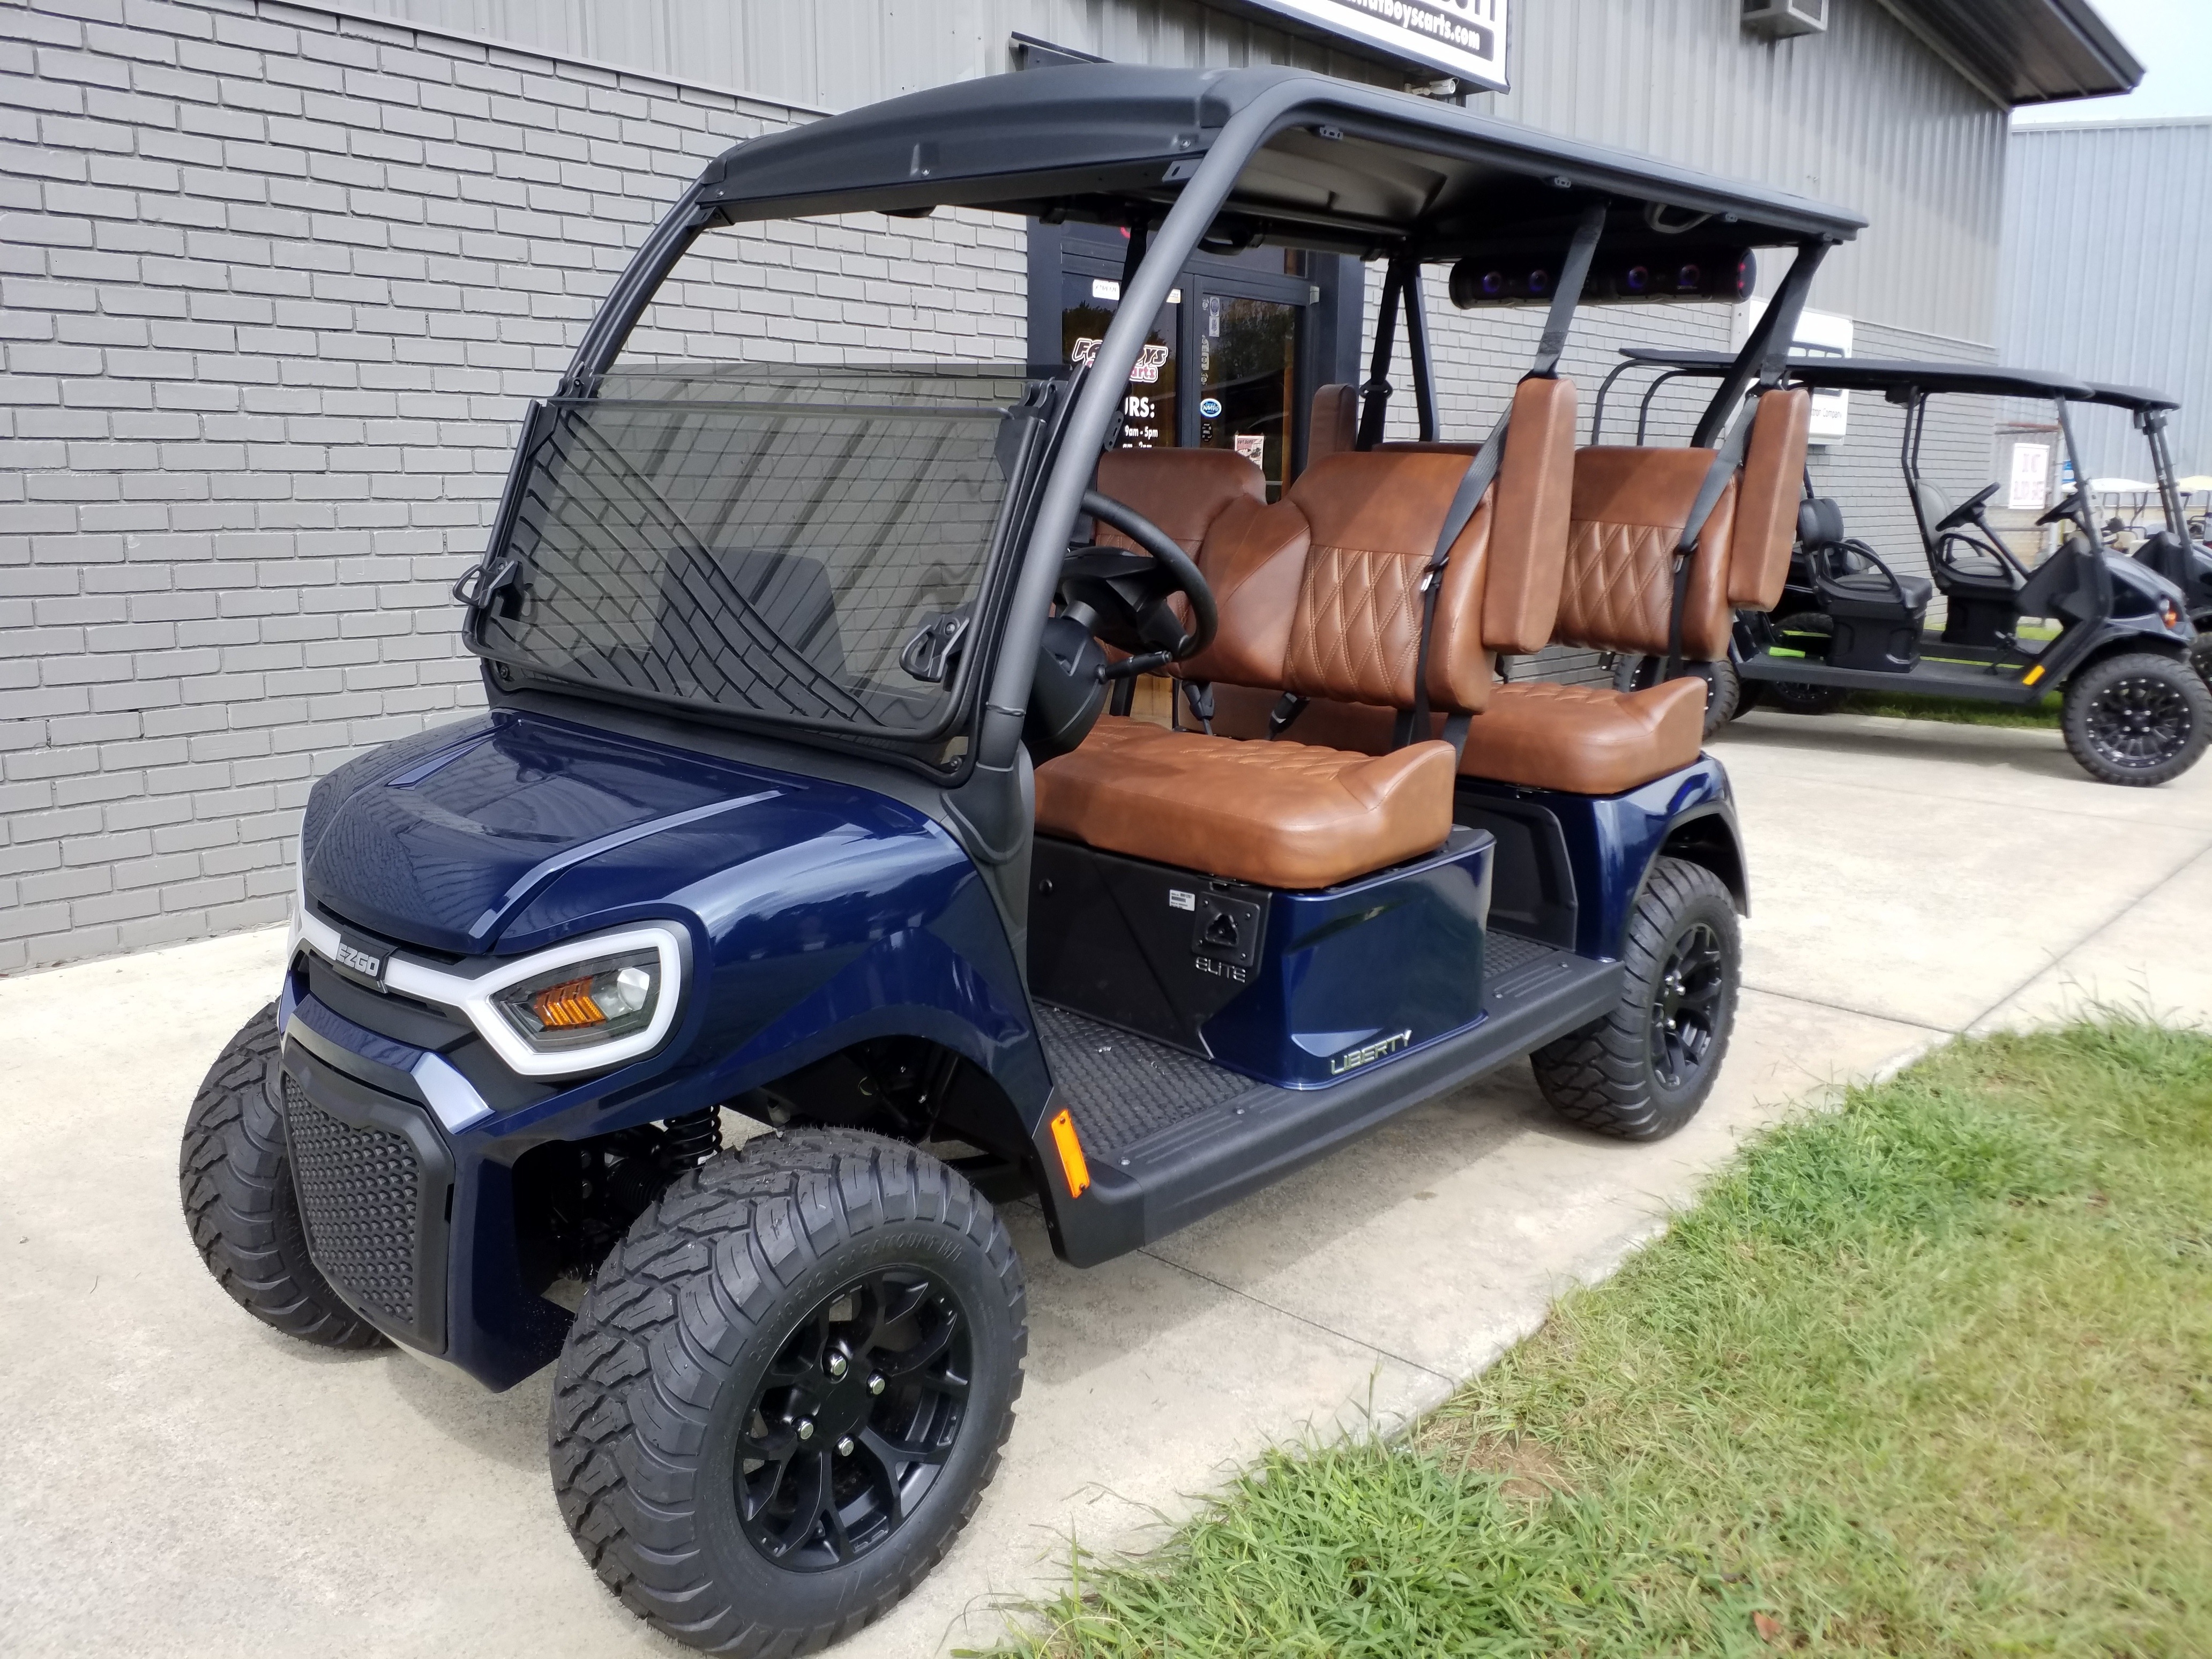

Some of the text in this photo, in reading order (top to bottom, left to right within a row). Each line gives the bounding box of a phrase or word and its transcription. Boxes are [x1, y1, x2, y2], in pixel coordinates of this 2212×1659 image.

[1125, 424, 1139, 437] 9am
[1145, 426, 1158, 439] 5pm
[1195, 956, 1246, 983] ELITE
[1331, 1030, 1412, 1075] LIBERTY
